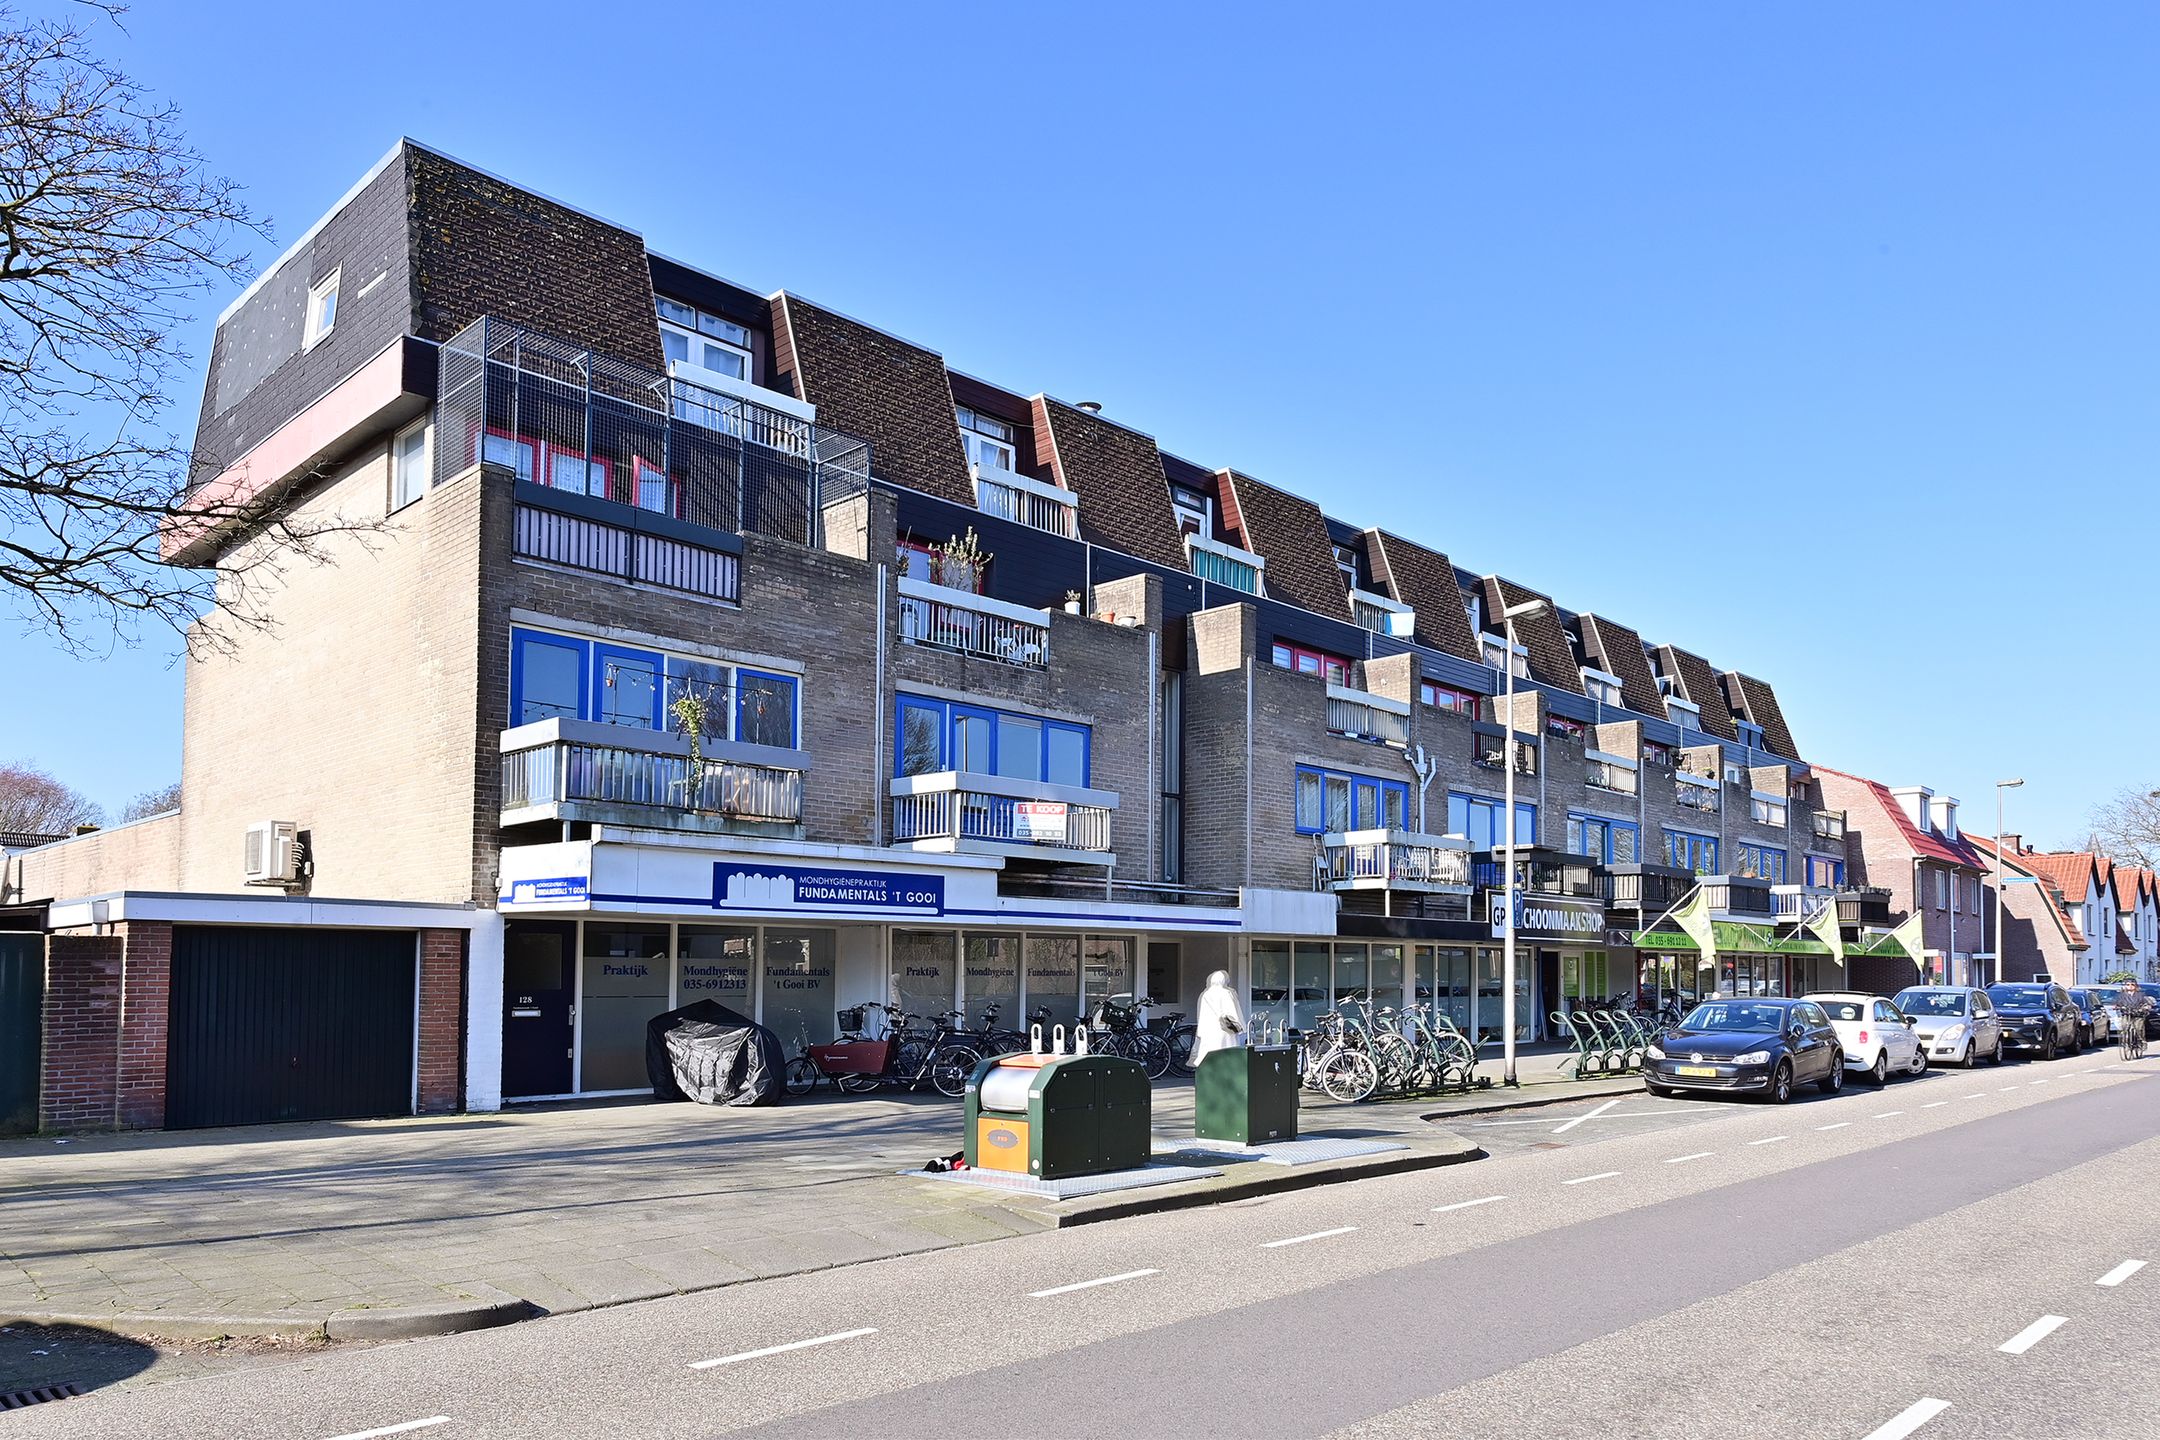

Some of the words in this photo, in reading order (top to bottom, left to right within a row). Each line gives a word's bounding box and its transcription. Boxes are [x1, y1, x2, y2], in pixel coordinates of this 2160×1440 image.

[1021, 805, 1032, 813] TE
[1036, 805, 1064, 814] KOOP
[799, 876, 887, 888] MONDHYGIËNEPRAKTIJK
[799, 887, 887, 902] FUNDAMENTALS
[892, 891, 901, 902] 'T
[906, 892, 936, 904] GOOI
[1523, 908, 1602, 933] CHOONMAAKSHOP
[603, 965, 648, 978] Praktijk
[683, 965, 748, 979] Mondhygiëne
[766, 966, 830, 977] Fundamentals
[906, 966, 940, 978] Praktijk
[1027, 968, 1076, 977] Fundamentals
[683, 979, 747, 990] 035-6912313
[783, 979, 805, 990] Gooi
[807, 980, 821, 989] BV
